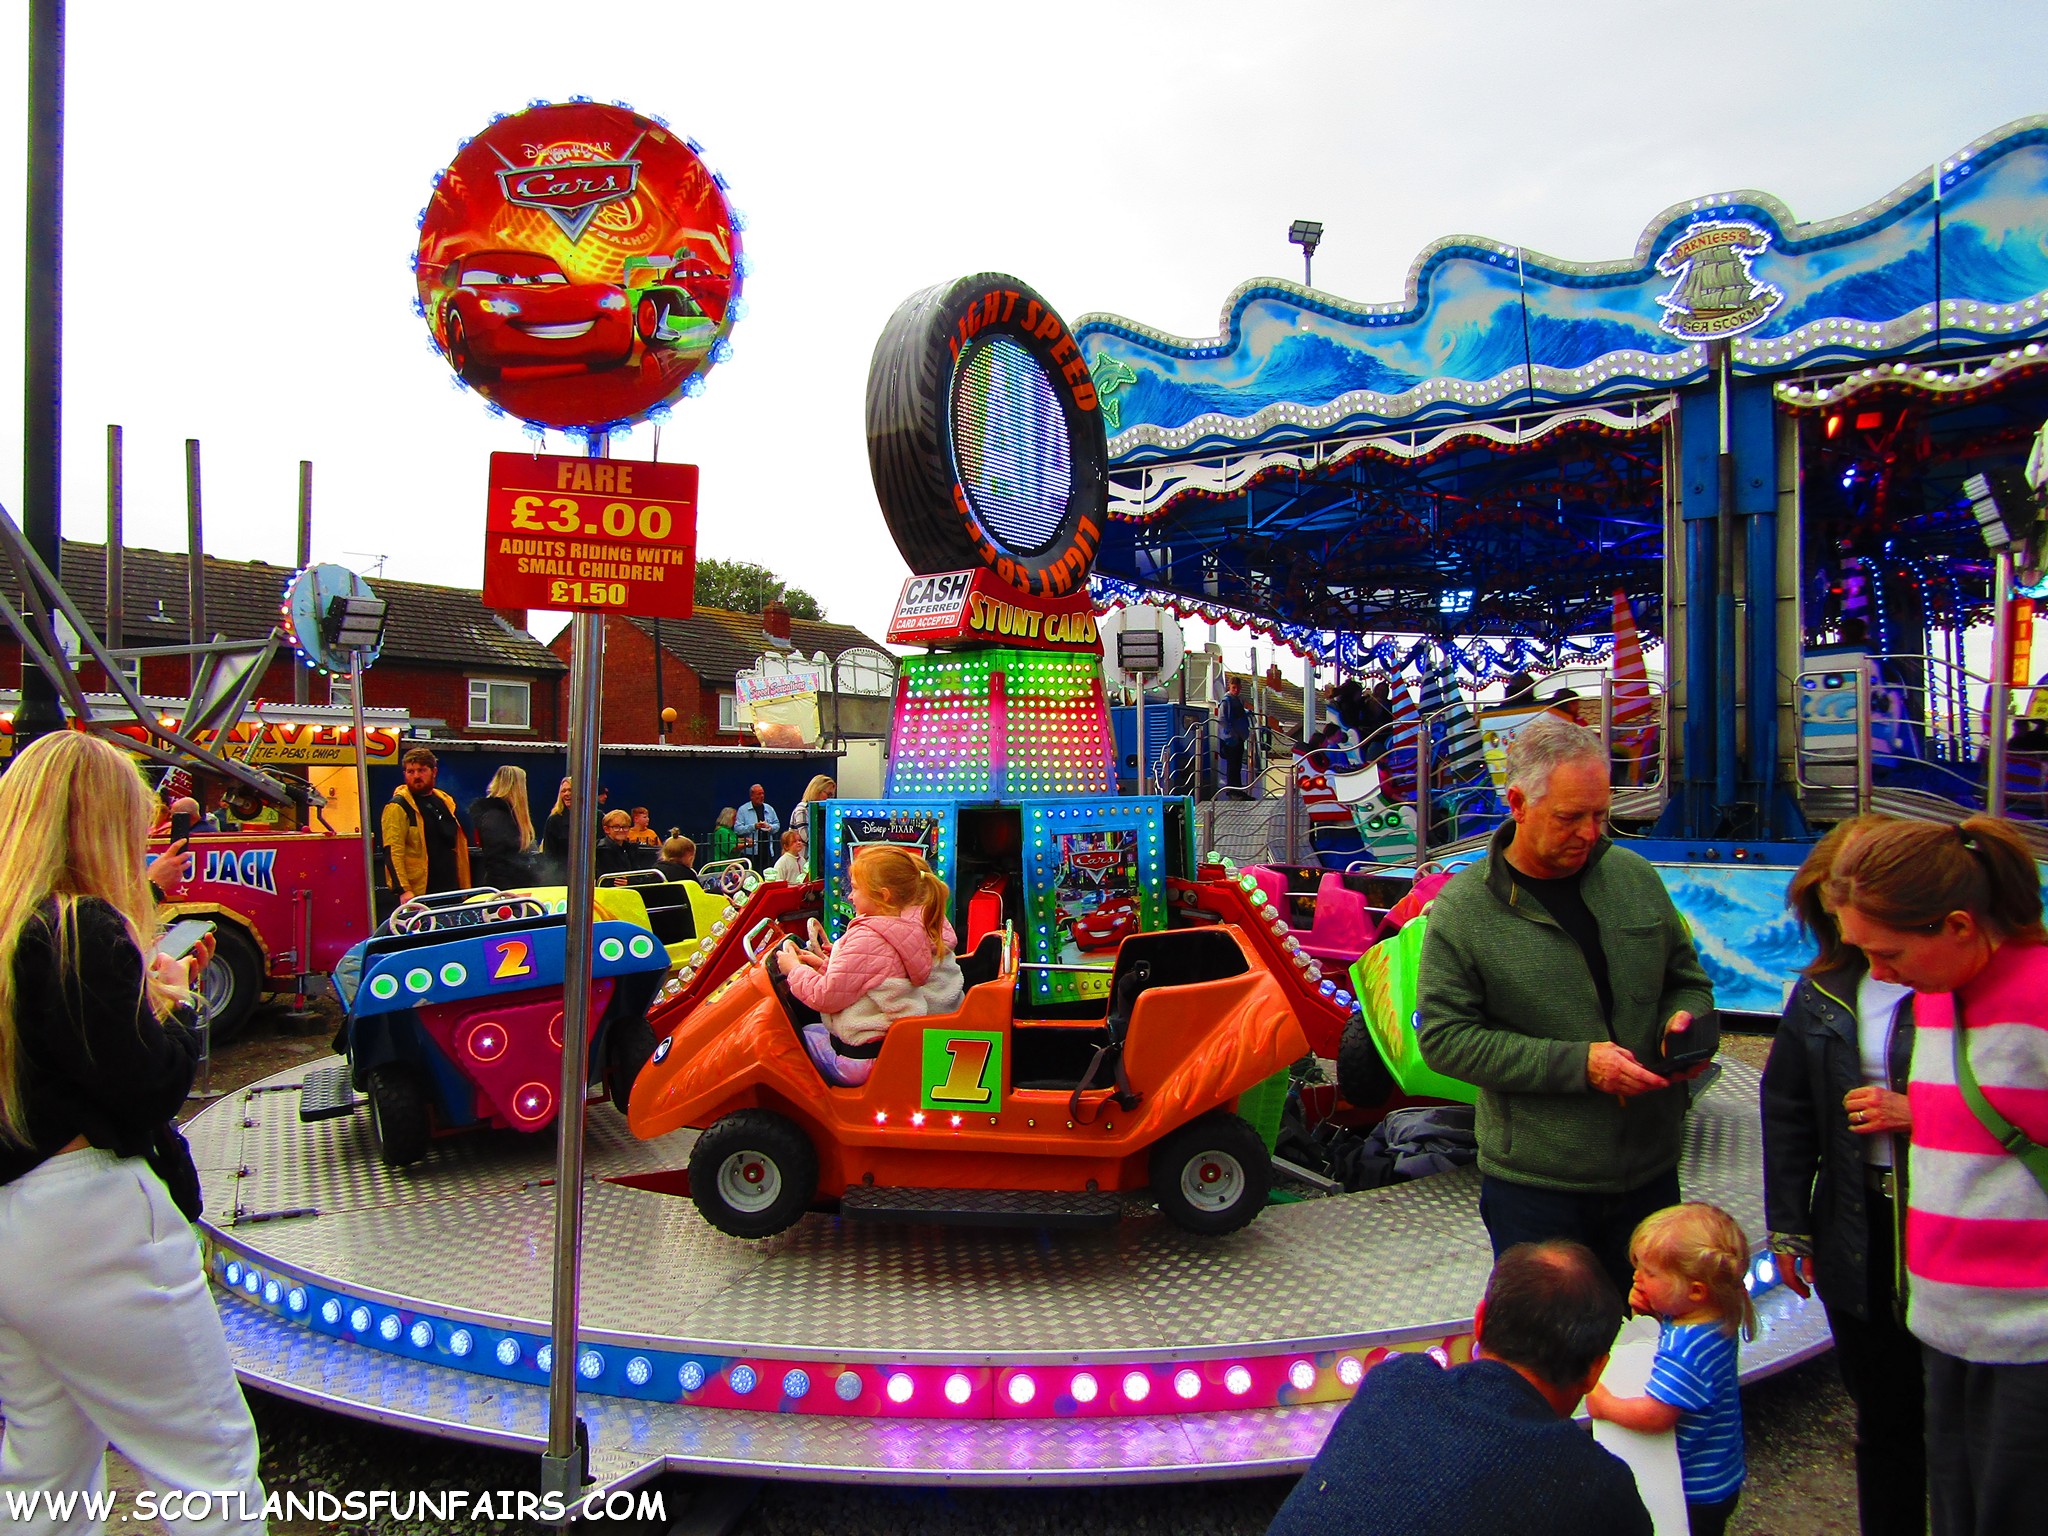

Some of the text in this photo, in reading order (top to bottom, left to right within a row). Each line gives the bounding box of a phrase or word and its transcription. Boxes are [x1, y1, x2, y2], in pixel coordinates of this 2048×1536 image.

[572, 141, 612, 153] PIXAR
[516, 173, 620, 198] Cars
[1682, 306, 1759, 333] SEA STORM
[1020, 299, 1099, 412] SPEED
[557, 461, 633, 494] FARE
[510, 495, 672, 540] £3.00
[500, 538, 684, 566] ADULTS RIDING WITH
[518, 557, 665, 582] SMALL CHILDREN
[551, 580, 626, 605] £1.50
[905, 574, 969, 606] CASH
[896, 614, 955, 629] CARD ACCEPTED
[899, 601, 960, 616] PREFERRED
[969, 591, 1097, 644] STUNT CARS
[279, 748, 306, 759] PEAS
[312, 749, 341, 760] CHIPS
[860, 820, 915, 838] Disney PIXAR
[203, 848, 278, 896] JACK
[1076, 854, 1115, 865] Cars
[494, 940, 531, 979] 2
[930, 1038, 993, 1104] 1
